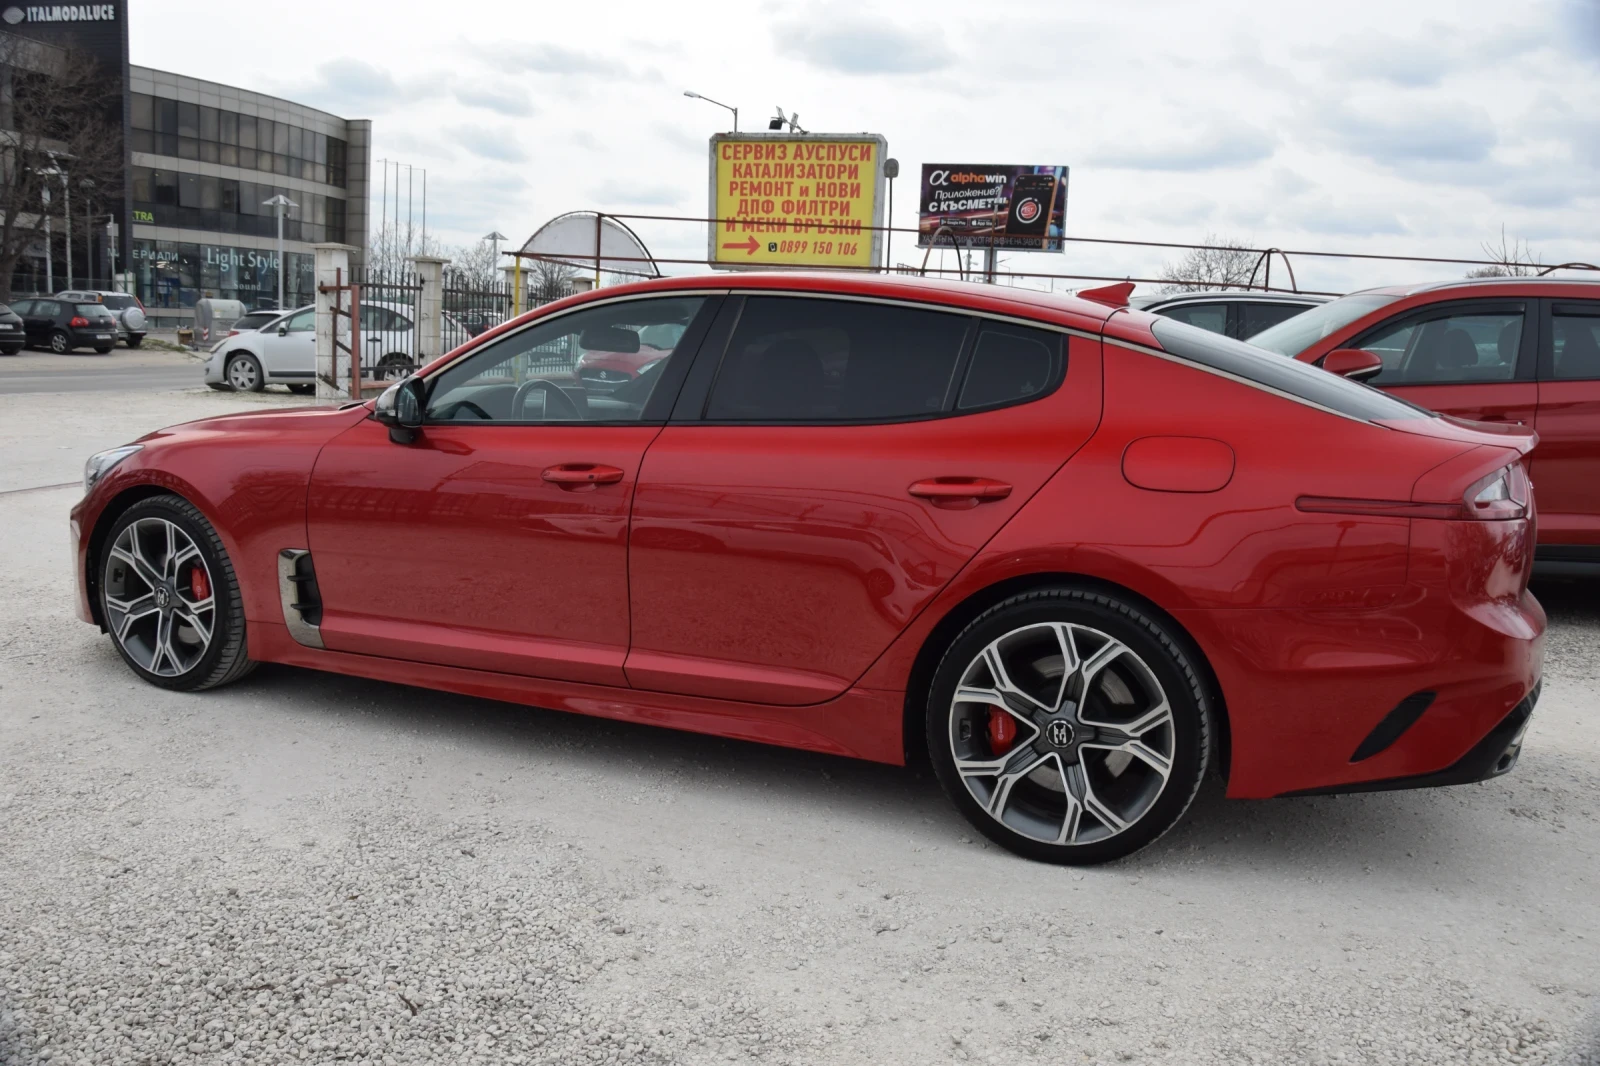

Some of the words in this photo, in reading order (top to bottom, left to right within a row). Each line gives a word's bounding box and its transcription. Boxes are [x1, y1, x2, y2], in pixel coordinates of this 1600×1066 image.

[26, 4, 116, 22] ITALMODALUCE
[722, 144, 788, 161] СЕРВИЗ
[793, 144, 872, 162] АУСПУСИ
[732, 163, 859, 180] КАТАЛИЗАТОРИ
[950, 172, 1008, 185] alphawin
[729, 181, 794, 197] РЕМОНТ
[815, 182, 861, 199] НОВИ
[737, 199, 775, 217] ДПФ
[781, 199, 850, 217] ФИЛТРИ
[725, 217, 737, 233] И
[741, 217, 787, 233] МЕКИ
[793, 218, 862, 235] ВРЪЗКИ
[779, 240, 809, 254] 0899
[812, 241, 833, 255] 150
[837, 242, 858, 256] 106
[207, 247, 245, 272] Light
[247, 251, 280, 274] Style
[243, 271, 250, 280] &
[233, 281, 262, 291] Sound
